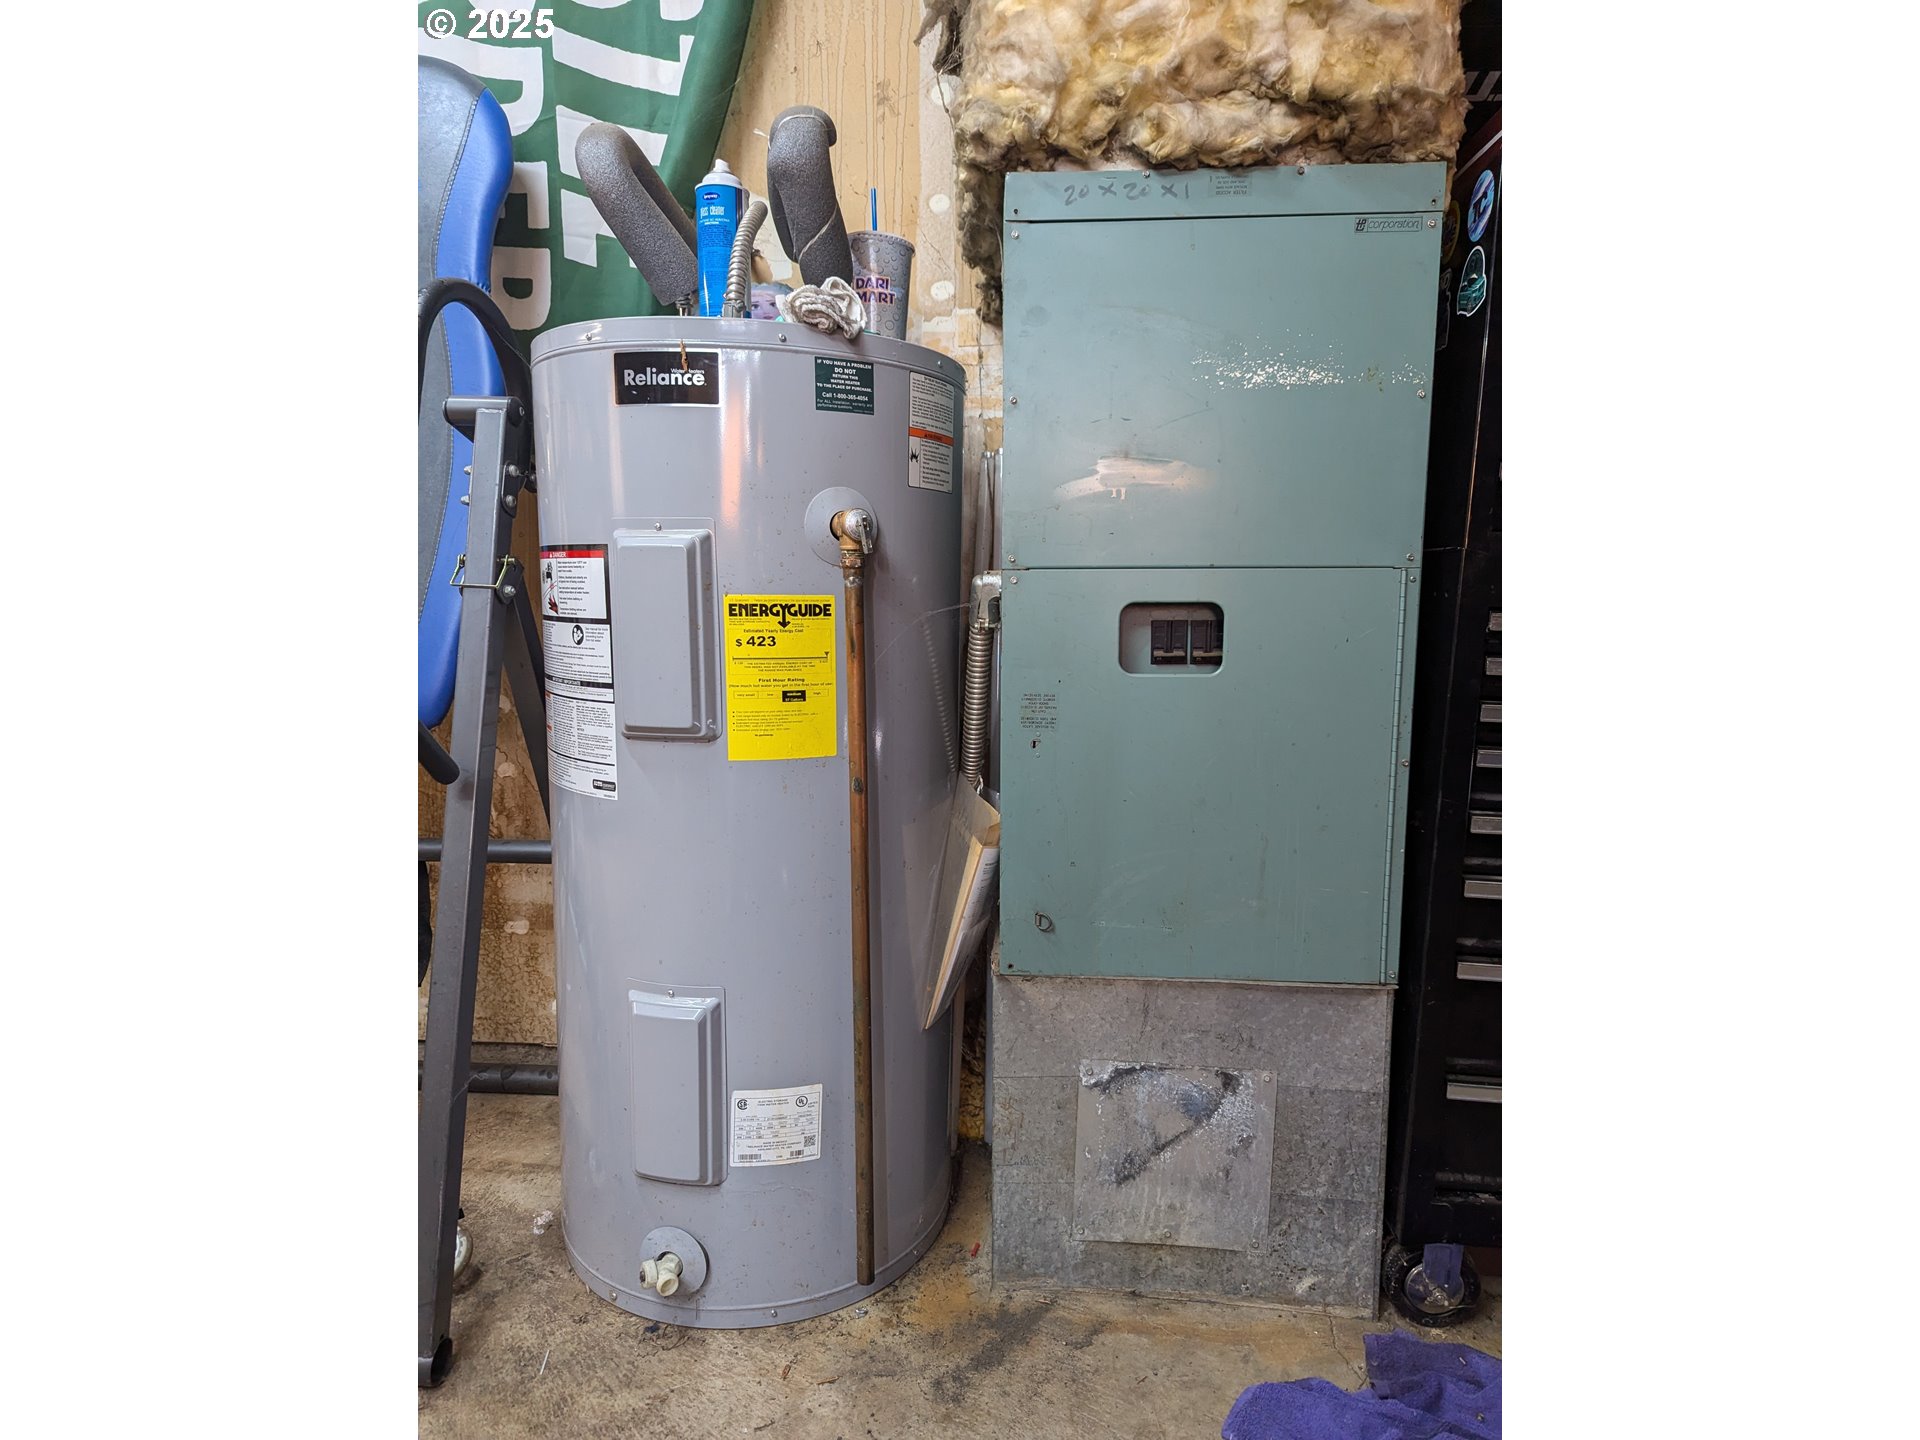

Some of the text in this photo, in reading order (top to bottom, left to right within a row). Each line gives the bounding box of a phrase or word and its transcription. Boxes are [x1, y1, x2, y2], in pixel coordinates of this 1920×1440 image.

[1369, 219, 1419, 230] corporation
[856, 278, 890, 289] DARI
[857, 291, 896, 304] MART
[624, 367, 705, 386] Reliance
[728, 603, 832, 617] ENERGYGUIDE
[746, 636, 776, 647] 423
